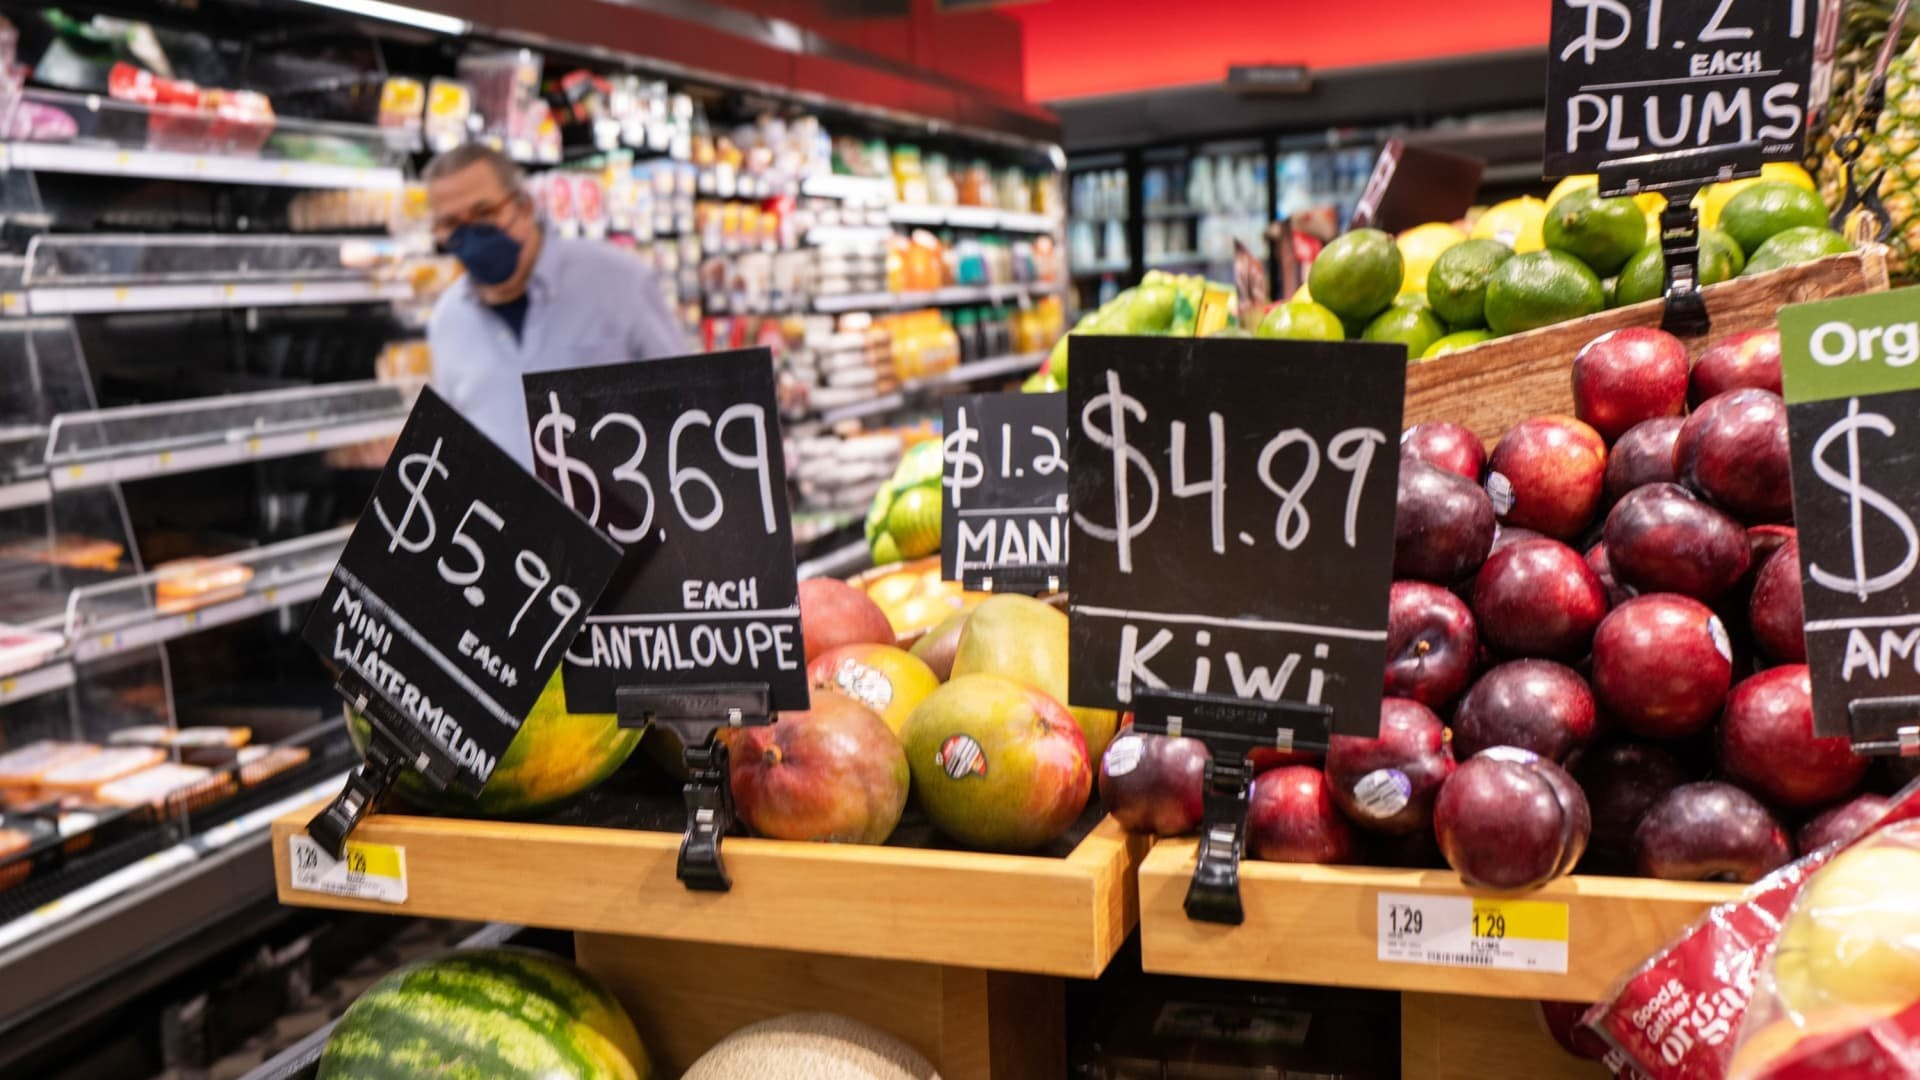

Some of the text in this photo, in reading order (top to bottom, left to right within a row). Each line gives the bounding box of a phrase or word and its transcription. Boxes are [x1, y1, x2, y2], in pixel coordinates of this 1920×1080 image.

[1689, 50, 1763, 77] EACH
[1566, 82, 1802, 153] PLUMS
[1809, 321, 1920, 367] Org
[534, 391, 777, 543] $3.69
[942, 406, 1069, 508] $1.2
[1073, 369, 1387, 573] $4.89
[373, 437, 582, 671] $5.99
[955, 516, 1069, 580] MAN
[332, 587, 393, 655] MINI
[682, 577, 758, 610] EACH
[457, 629, 518, 688] EACH
[1117, 625, 1330, 704] Kiwi
[333, 622, 496, 783] WATERMELON
[1389, 906, 1424, 935] 1.29
[1472, 914, 1506, 939] 1.29
